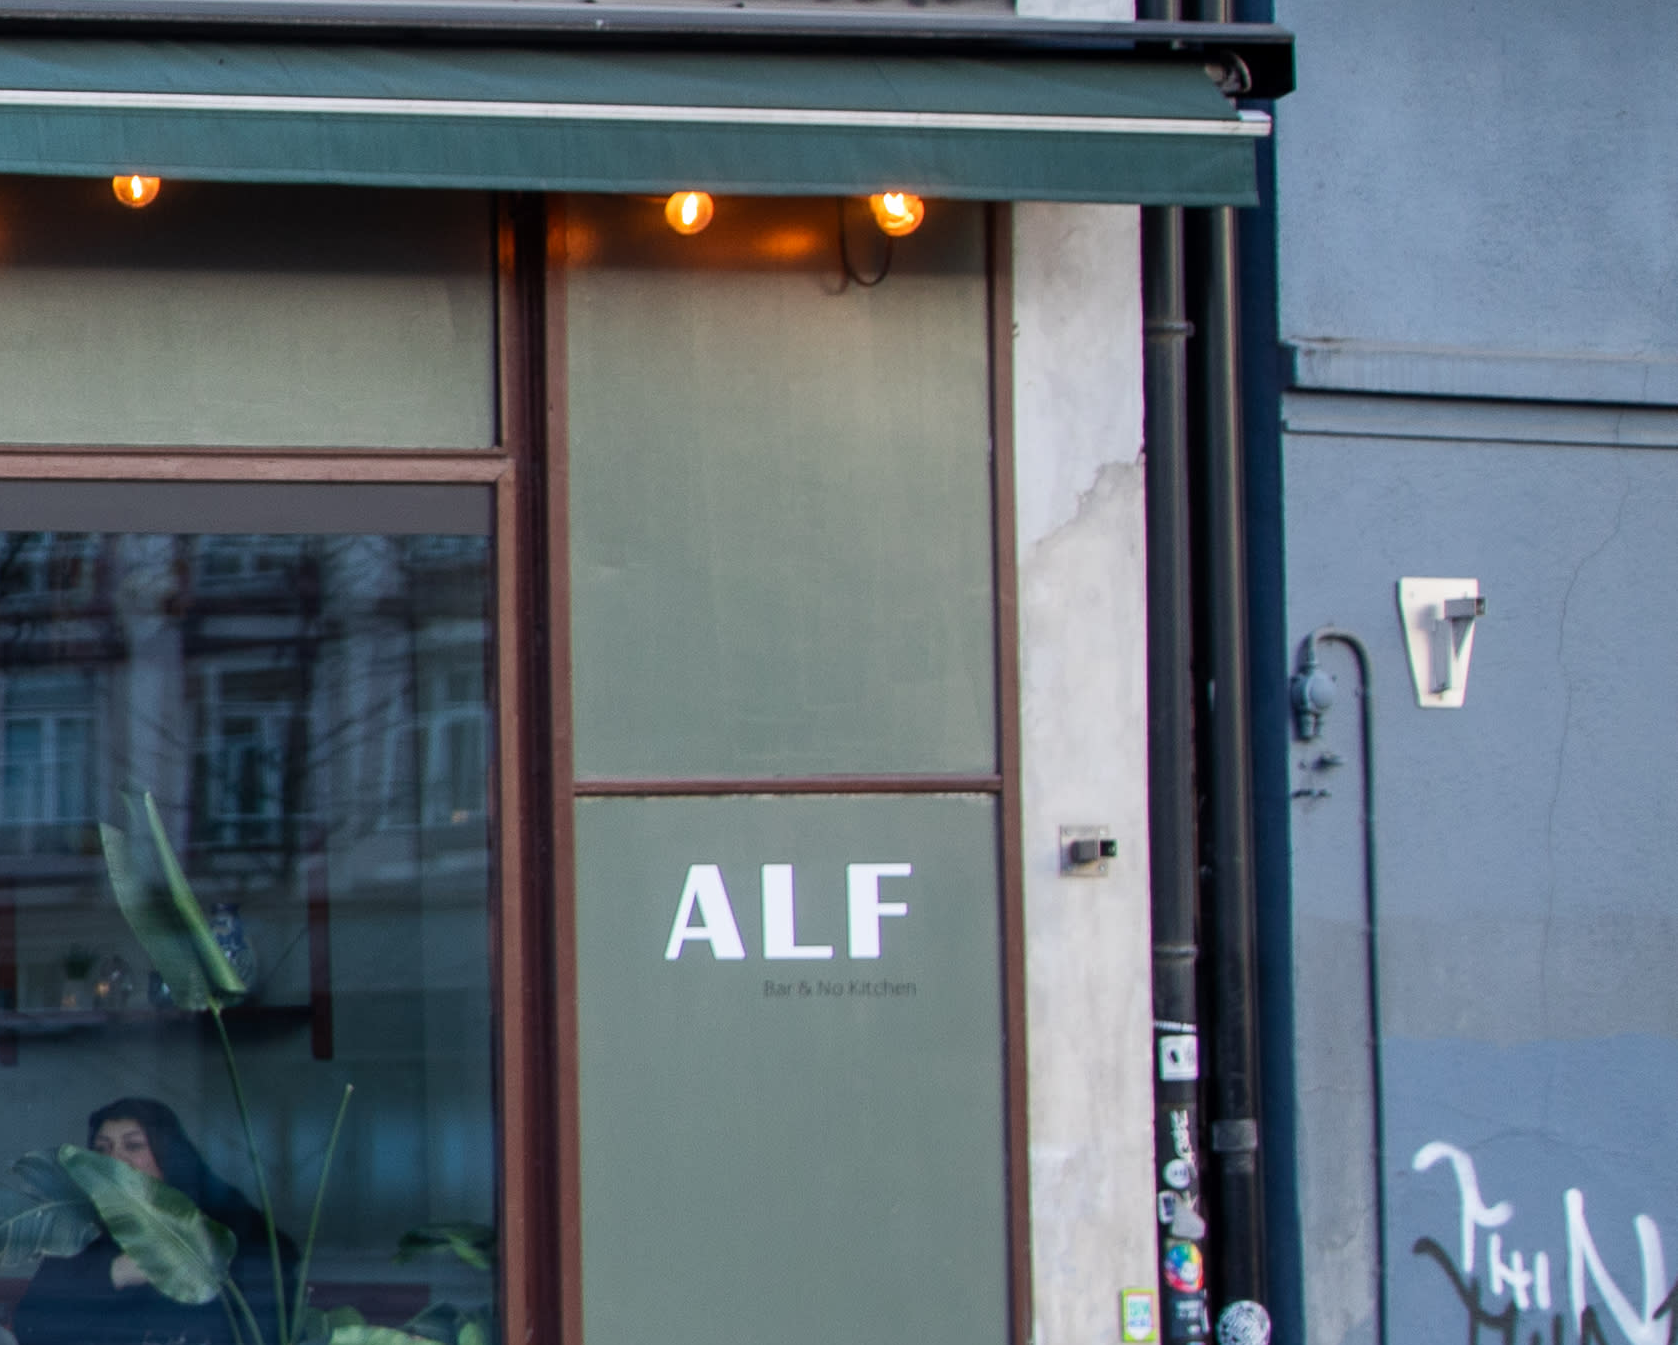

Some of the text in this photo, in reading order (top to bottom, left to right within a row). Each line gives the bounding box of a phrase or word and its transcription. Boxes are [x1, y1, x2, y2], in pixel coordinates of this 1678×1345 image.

[664, 863, 913, 960] ALF
[763, 979, 917, 998] Bar & No Kitchen
